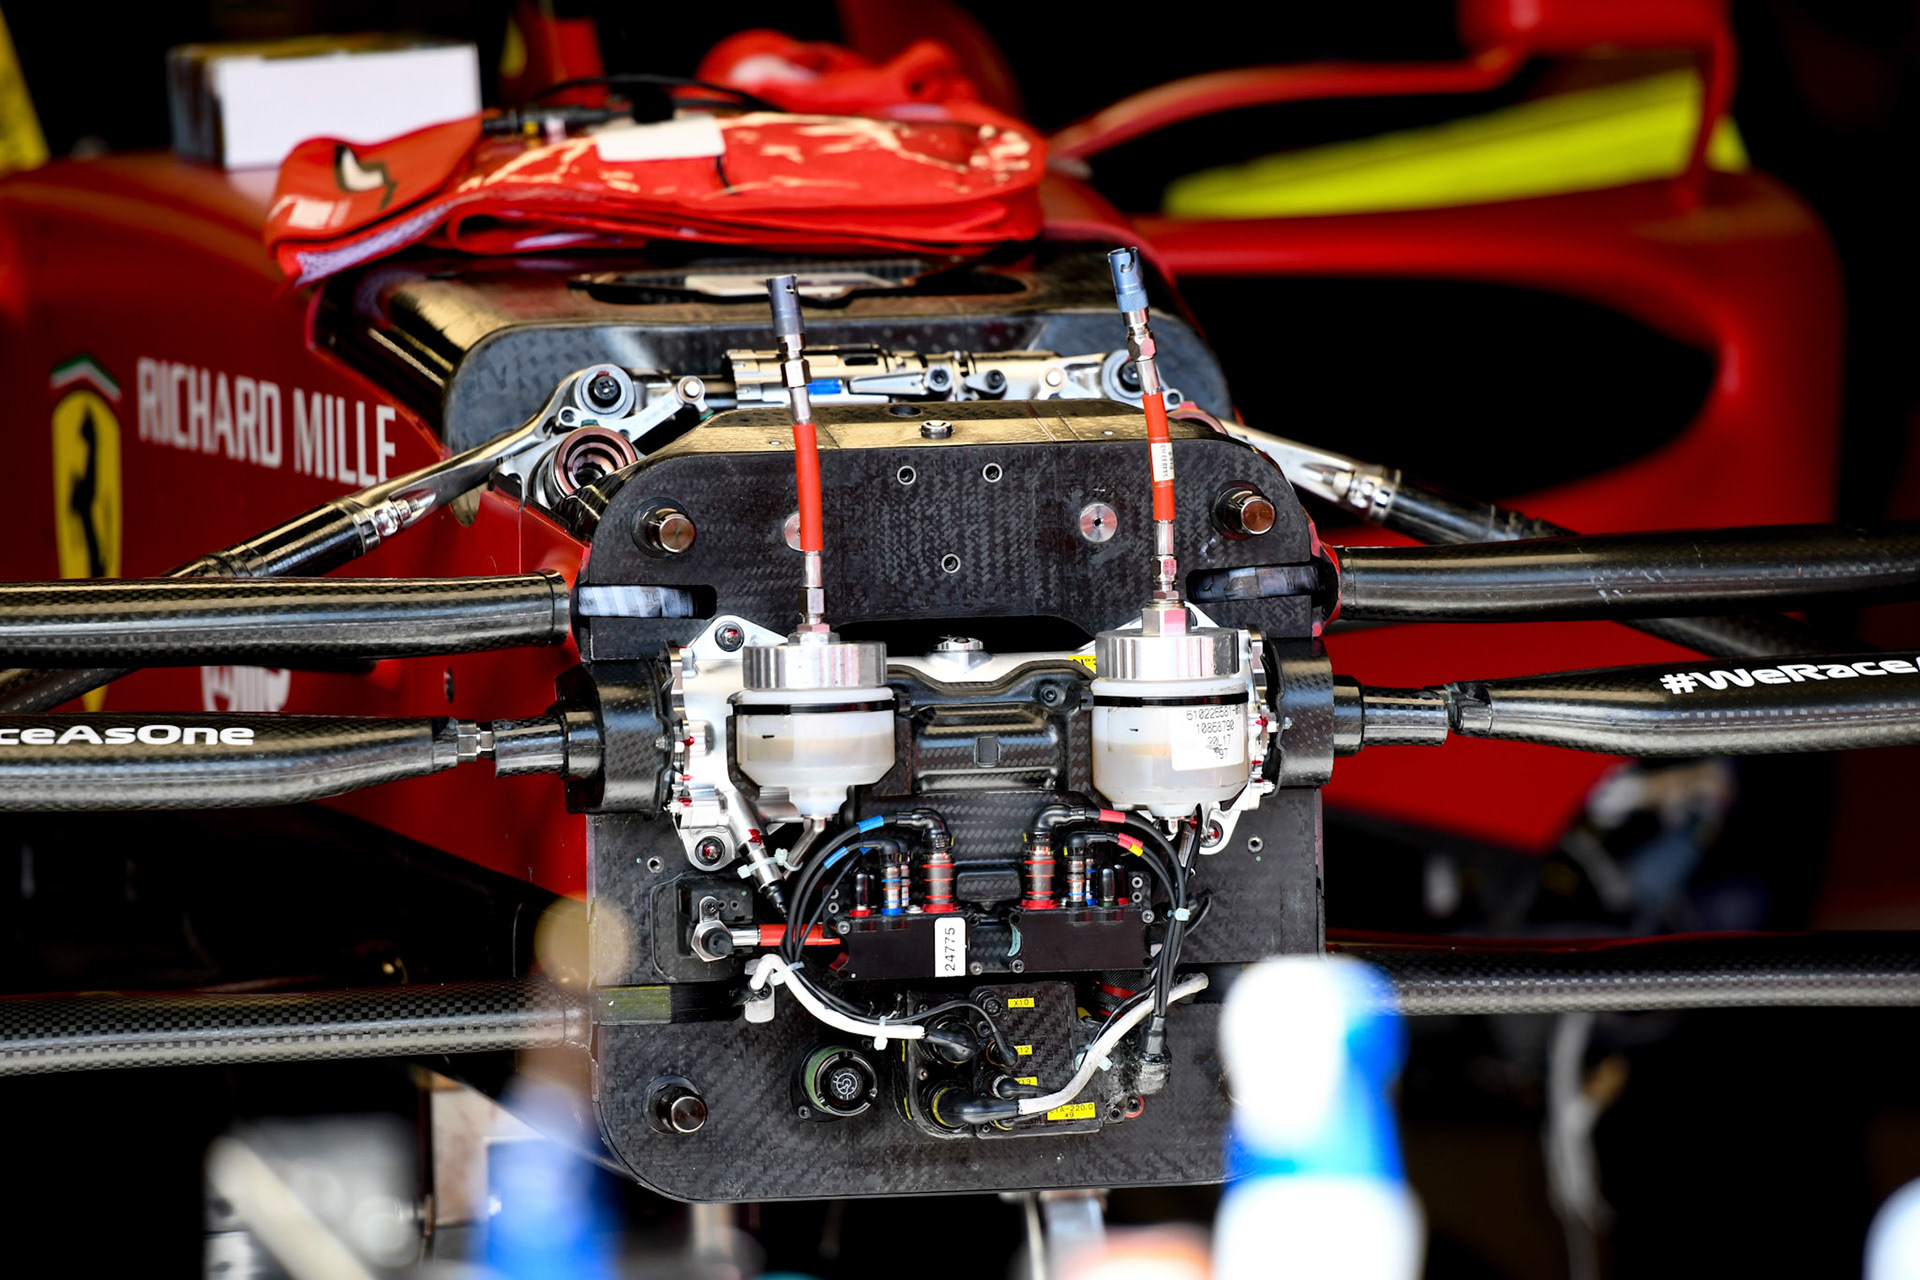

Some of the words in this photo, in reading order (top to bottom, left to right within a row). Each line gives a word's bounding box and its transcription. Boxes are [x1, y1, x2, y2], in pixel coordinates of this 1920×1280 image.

[137, 356, 282, 468] RICHARD
[293, 387, 396, 486] MILLE
[1659, 656, 1920, 695] #WeRace
[944, 927, 956, 972] 24775
[1013, 999, 1030, 1007] X10
